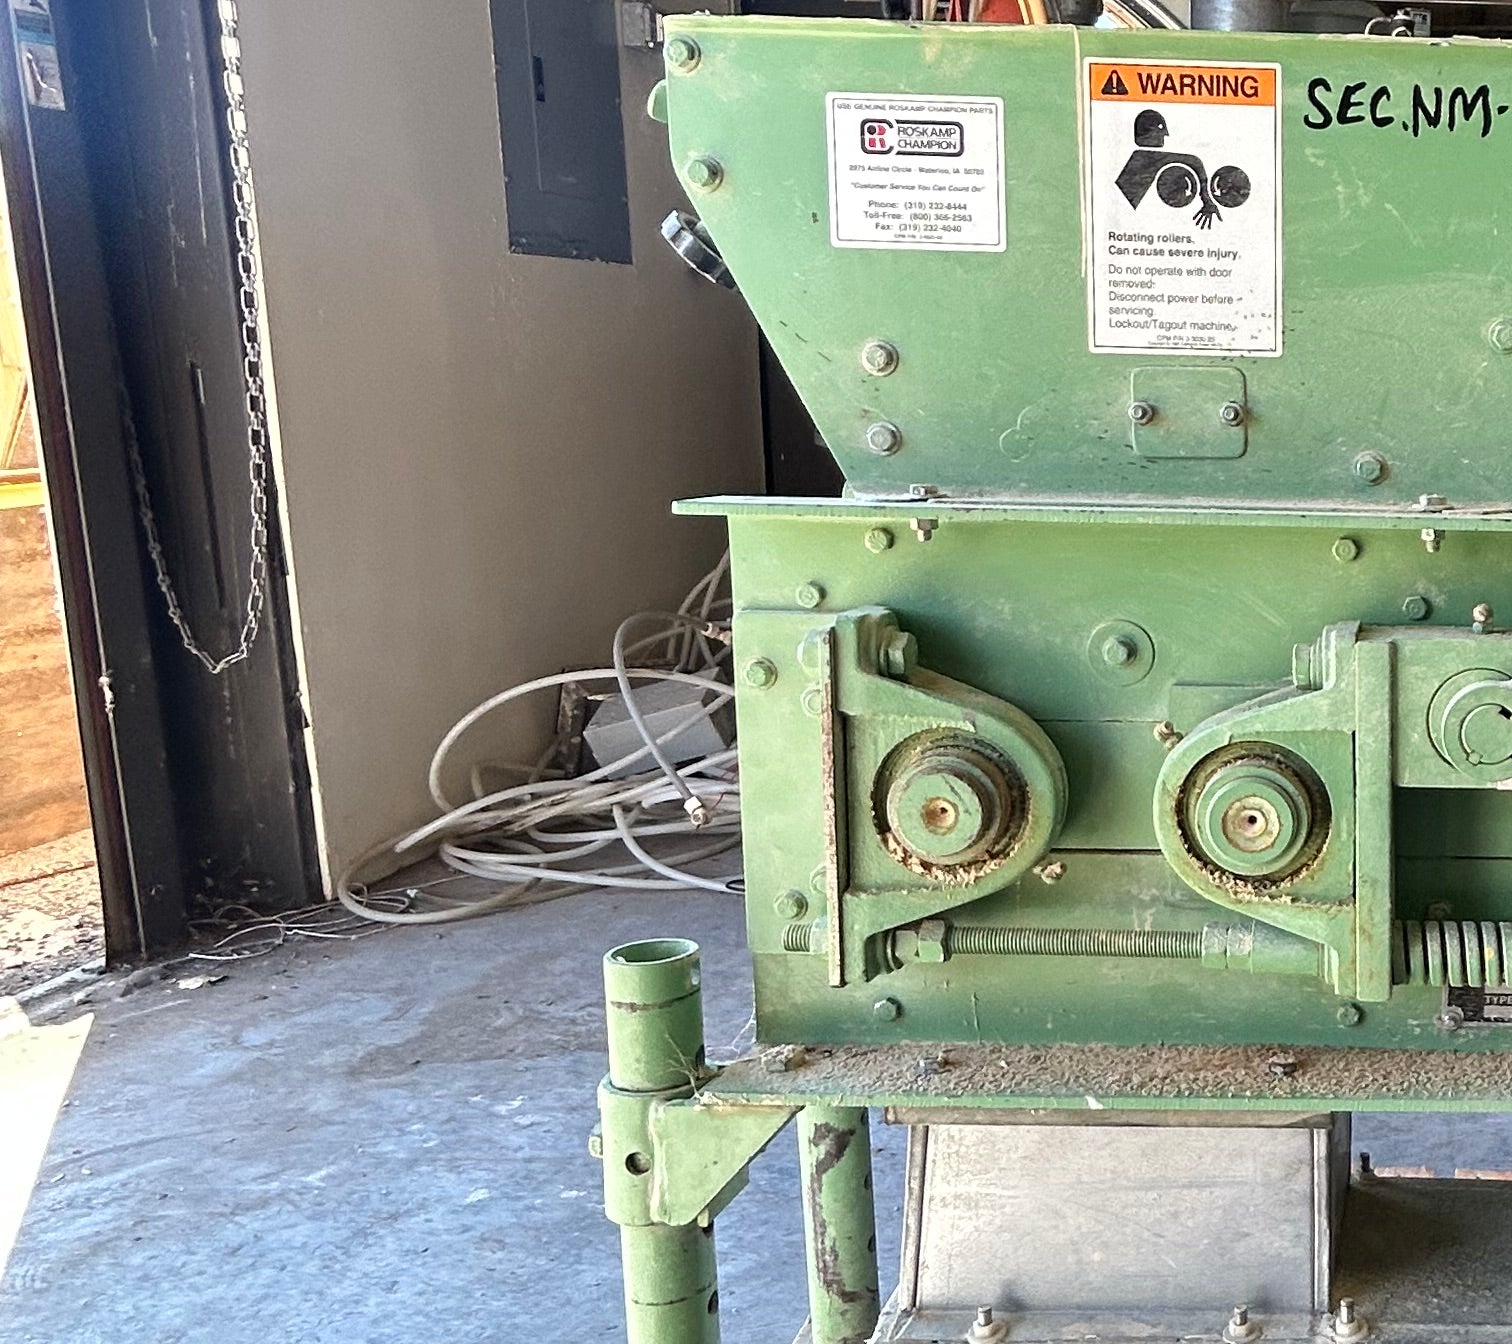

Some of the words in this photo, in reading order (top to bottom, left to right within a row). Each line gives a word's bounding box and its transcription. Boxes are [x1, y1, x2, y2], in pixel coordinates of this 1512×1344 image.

[1137, 72, 1259, 98] WARNING
[898, 126, 956, 137] ROSKAMP
[898, 139, 957, 150] CHAMPION
[868, 200, 899, 209] Phone:
[864, 211, 904, 220] Toll-Free:
[875, 222, 894, 231] Fax:
[1108, 231, 1154, 245] Rotating
[1157, 233, 1195, 244] rollers.
[1108, 245, 1130, 255] Can
[1132, 247, 1165, 257] cause
[1168, 248, 1204, 258] severe
[1208, 248, 1241, 261] injury.
[1108, 264, 1123, 274] Do
[1126, 266, 1141, 275] not
[1144, 266, 1183, 277] operate
[1186, 267, 1206, 276] with
[1209, 267, 1232, 277] door
[1109, 291, 1165, 302] Disconnect
[1168, 294, 1198, 305] power
[1202, 294, 1233, 304] before
[1109, 318, 1187, 332] Lockout/Tagout
